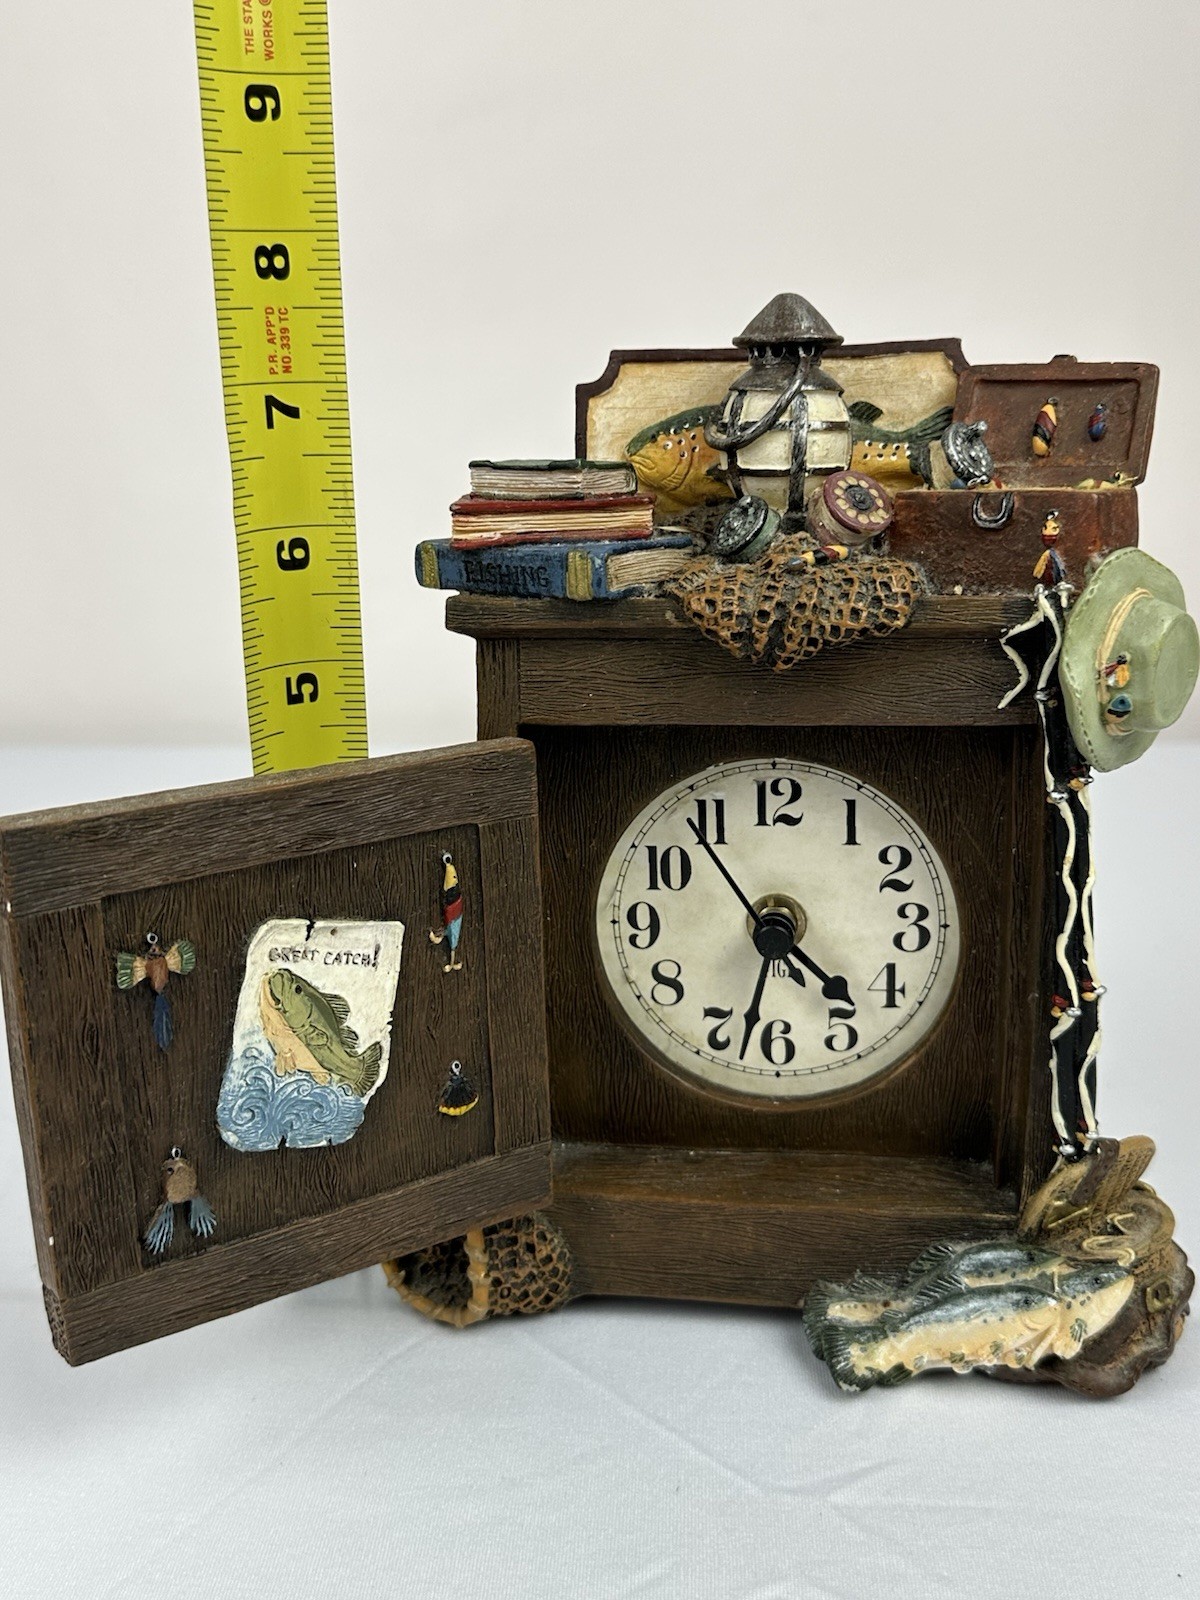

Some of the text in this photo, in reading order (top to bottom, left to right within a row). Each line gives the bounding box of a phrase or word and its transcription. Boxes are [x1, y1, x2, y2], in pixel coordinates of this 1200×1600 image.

[243, 28, 255, 55] THE
[262, 10, 275, 61] WORKS
[244, 84, 281, 122] 9
[254, 243, 291, 281] 8
[278, 306, 289, 324] TC
[264, 305, 279, 375] P.R. APP'D
[264, 394, 300, 429] 7
[276, 537, 310, 572] 6
[464, 560, 550, 588] FISHING
[285, 672, 319, 706] 5
[694, 799, 728, 846] 11
[753, 777, 804, 827] 12
[842, 799, 862, 846] 1
[645, 845, 692, 891] 10
[878, 845, 914, 893] 2
[626, 901, 661, 949] 9
[893, 902, 931, 953] 3
[268, 943, 381, 971] GREAT CATCH!
[651, 959, 684, 1006] 8
[867, 962, 906, 1008] 4
[703, 1006, 733, 1051] 7
[760, 1019, 796, 1065] 6
[824, 1006, 858, 1051] 5
